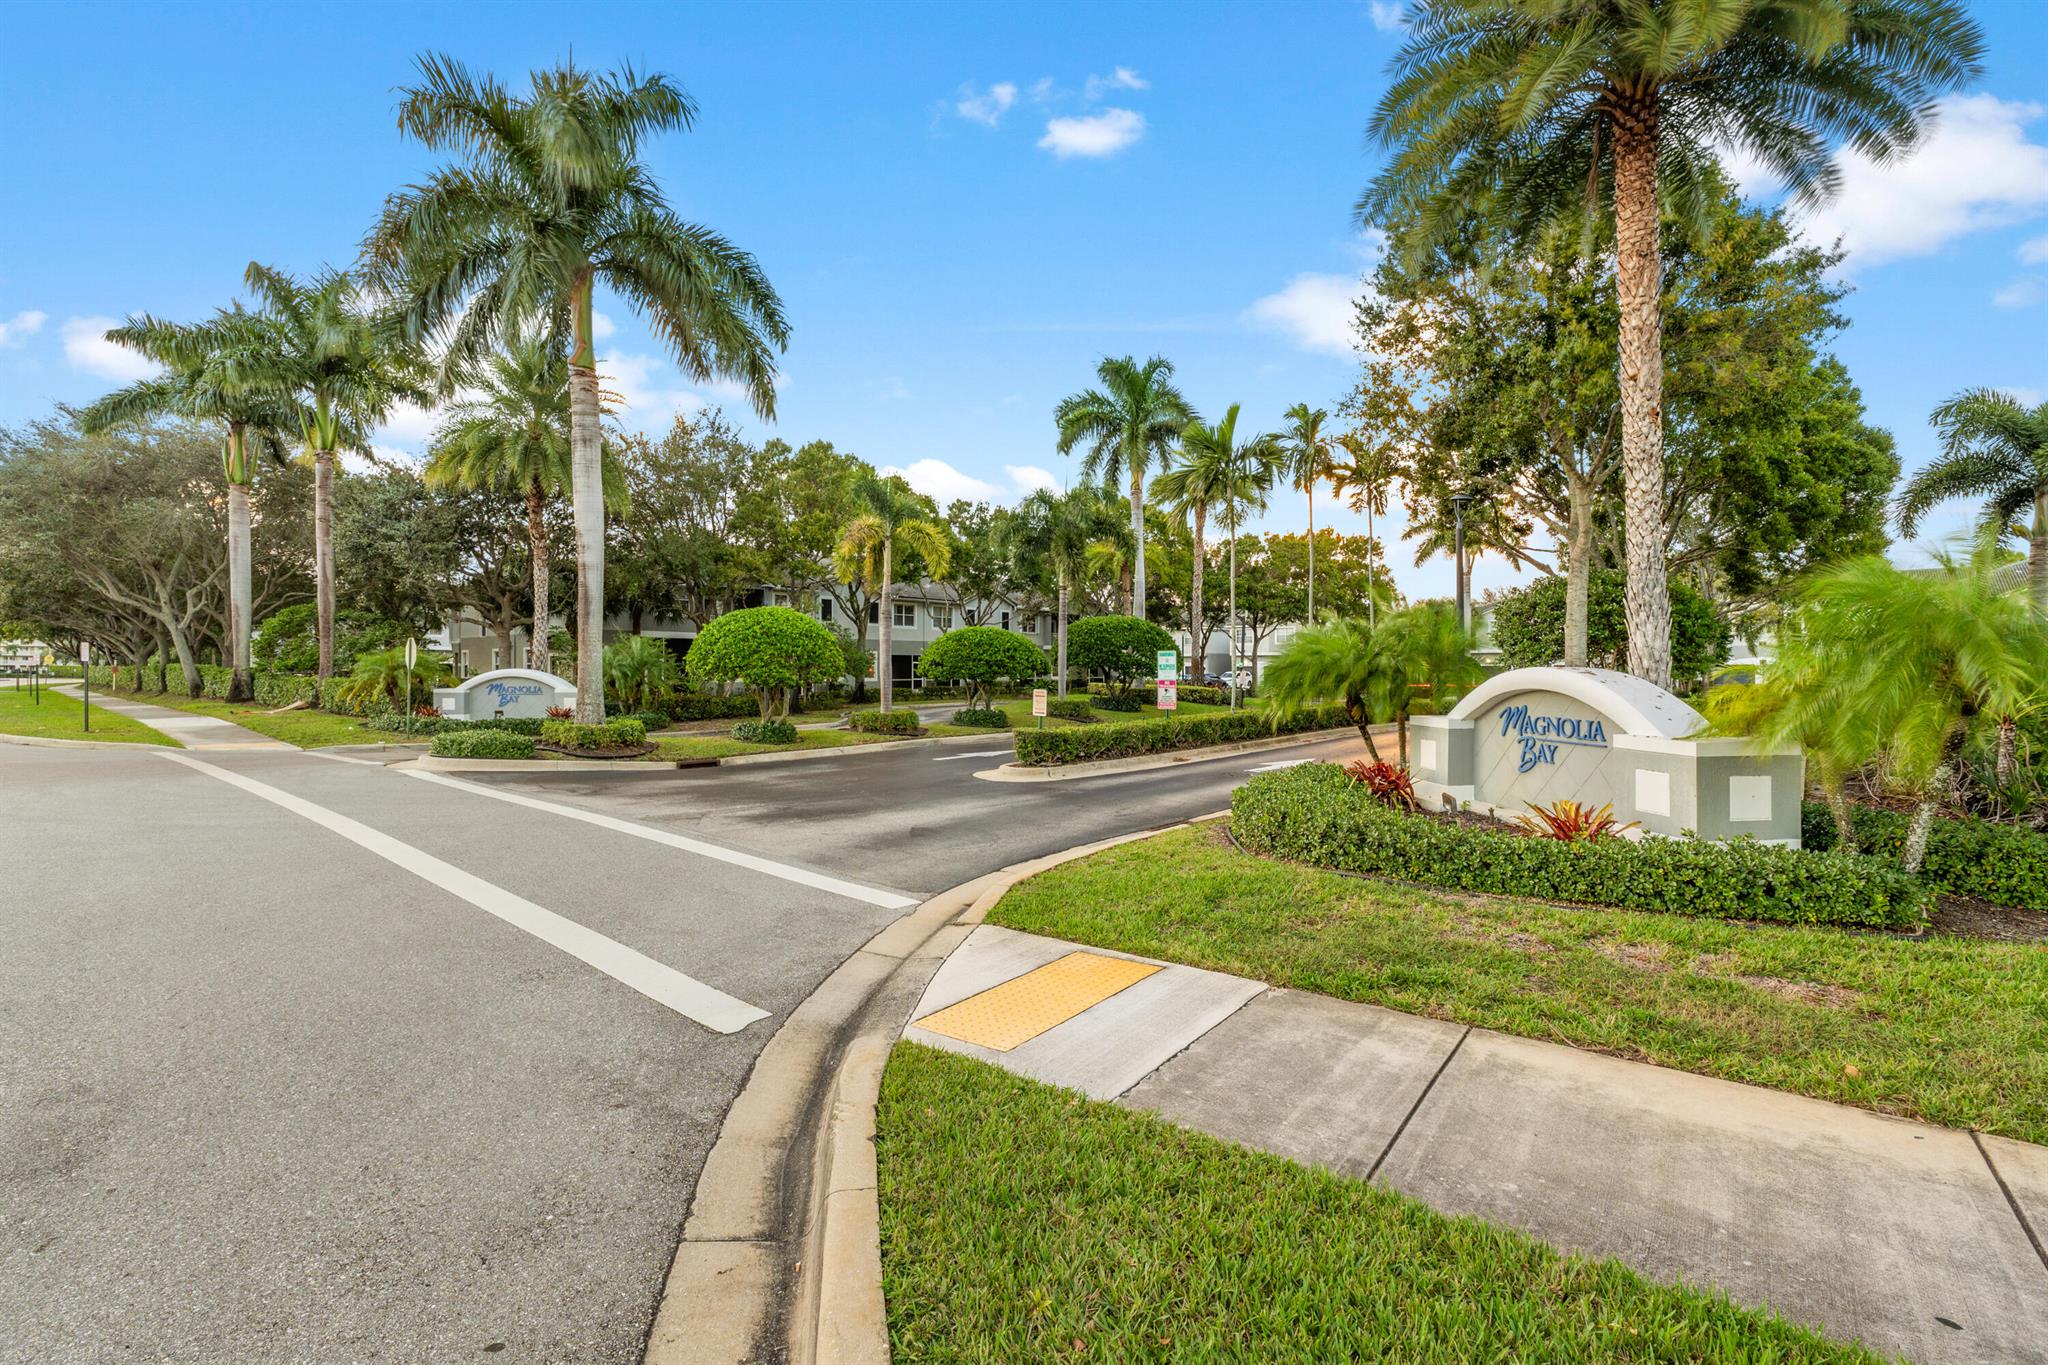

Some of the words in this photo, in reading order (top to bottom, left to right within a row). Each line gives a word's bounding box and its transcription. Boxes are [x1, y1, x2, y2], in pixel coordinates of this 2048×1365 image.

[486, 683, 543, 695] MAGNOLIA
[498, 694, 520, 707] BAY
[1499, 704, 1607, 742] MAGNOLIA
[1517, 736, 1558, 773] BAY
